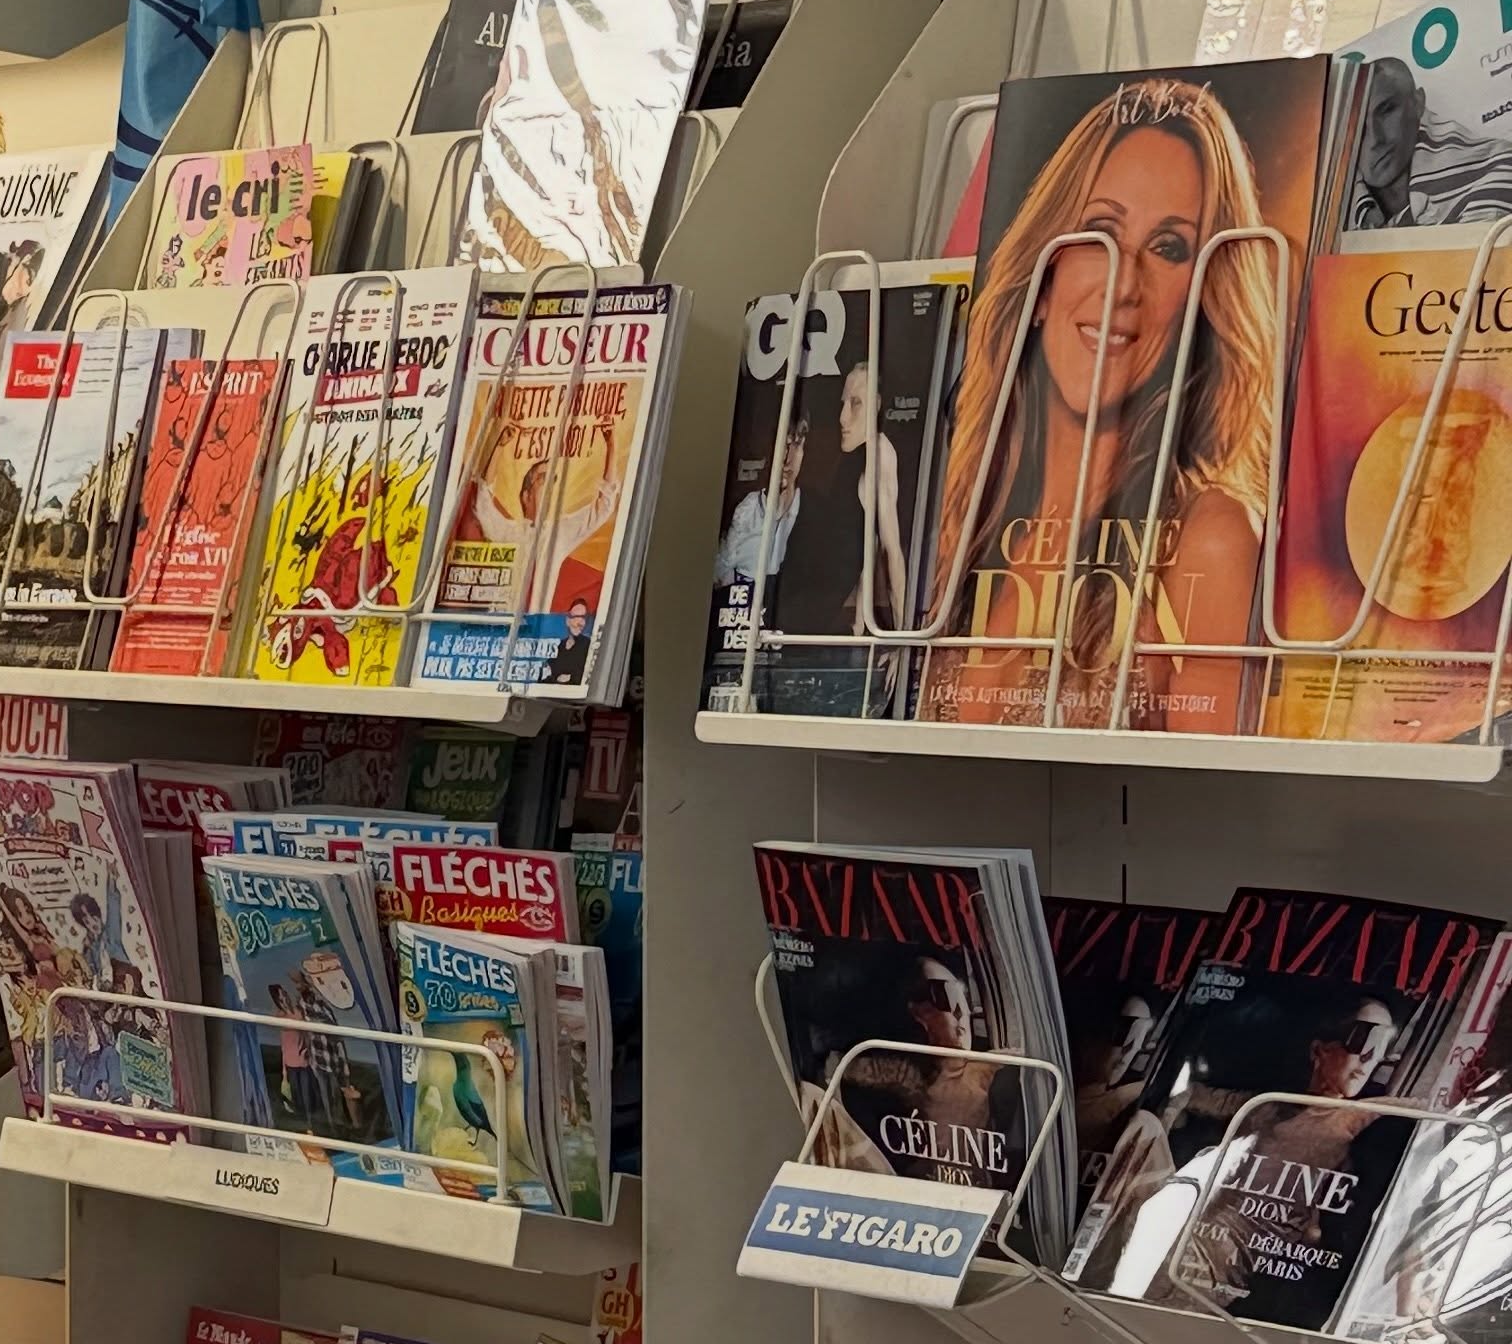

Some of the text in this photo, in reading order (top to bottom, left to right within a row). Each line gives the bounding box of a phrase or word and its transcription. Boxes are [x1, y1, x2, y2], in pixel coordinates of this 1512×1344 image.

[185, 159, 282, 223] le cri
[483, 321, 651, 369] CAUSEUR
[745, 287, 848, 382] GQ
[1000, 504, 1185, 568] CÉLINE
[960, 566, 1210, 676] DION
[400, 852, 556, 906] FLÉCHÉS
[414, 932, 518, 995] FLÉCHÉS
[878, 1108, 1009, 1174] CÉLINE
[765, 1200, 966, 1259] LE FIGARO
